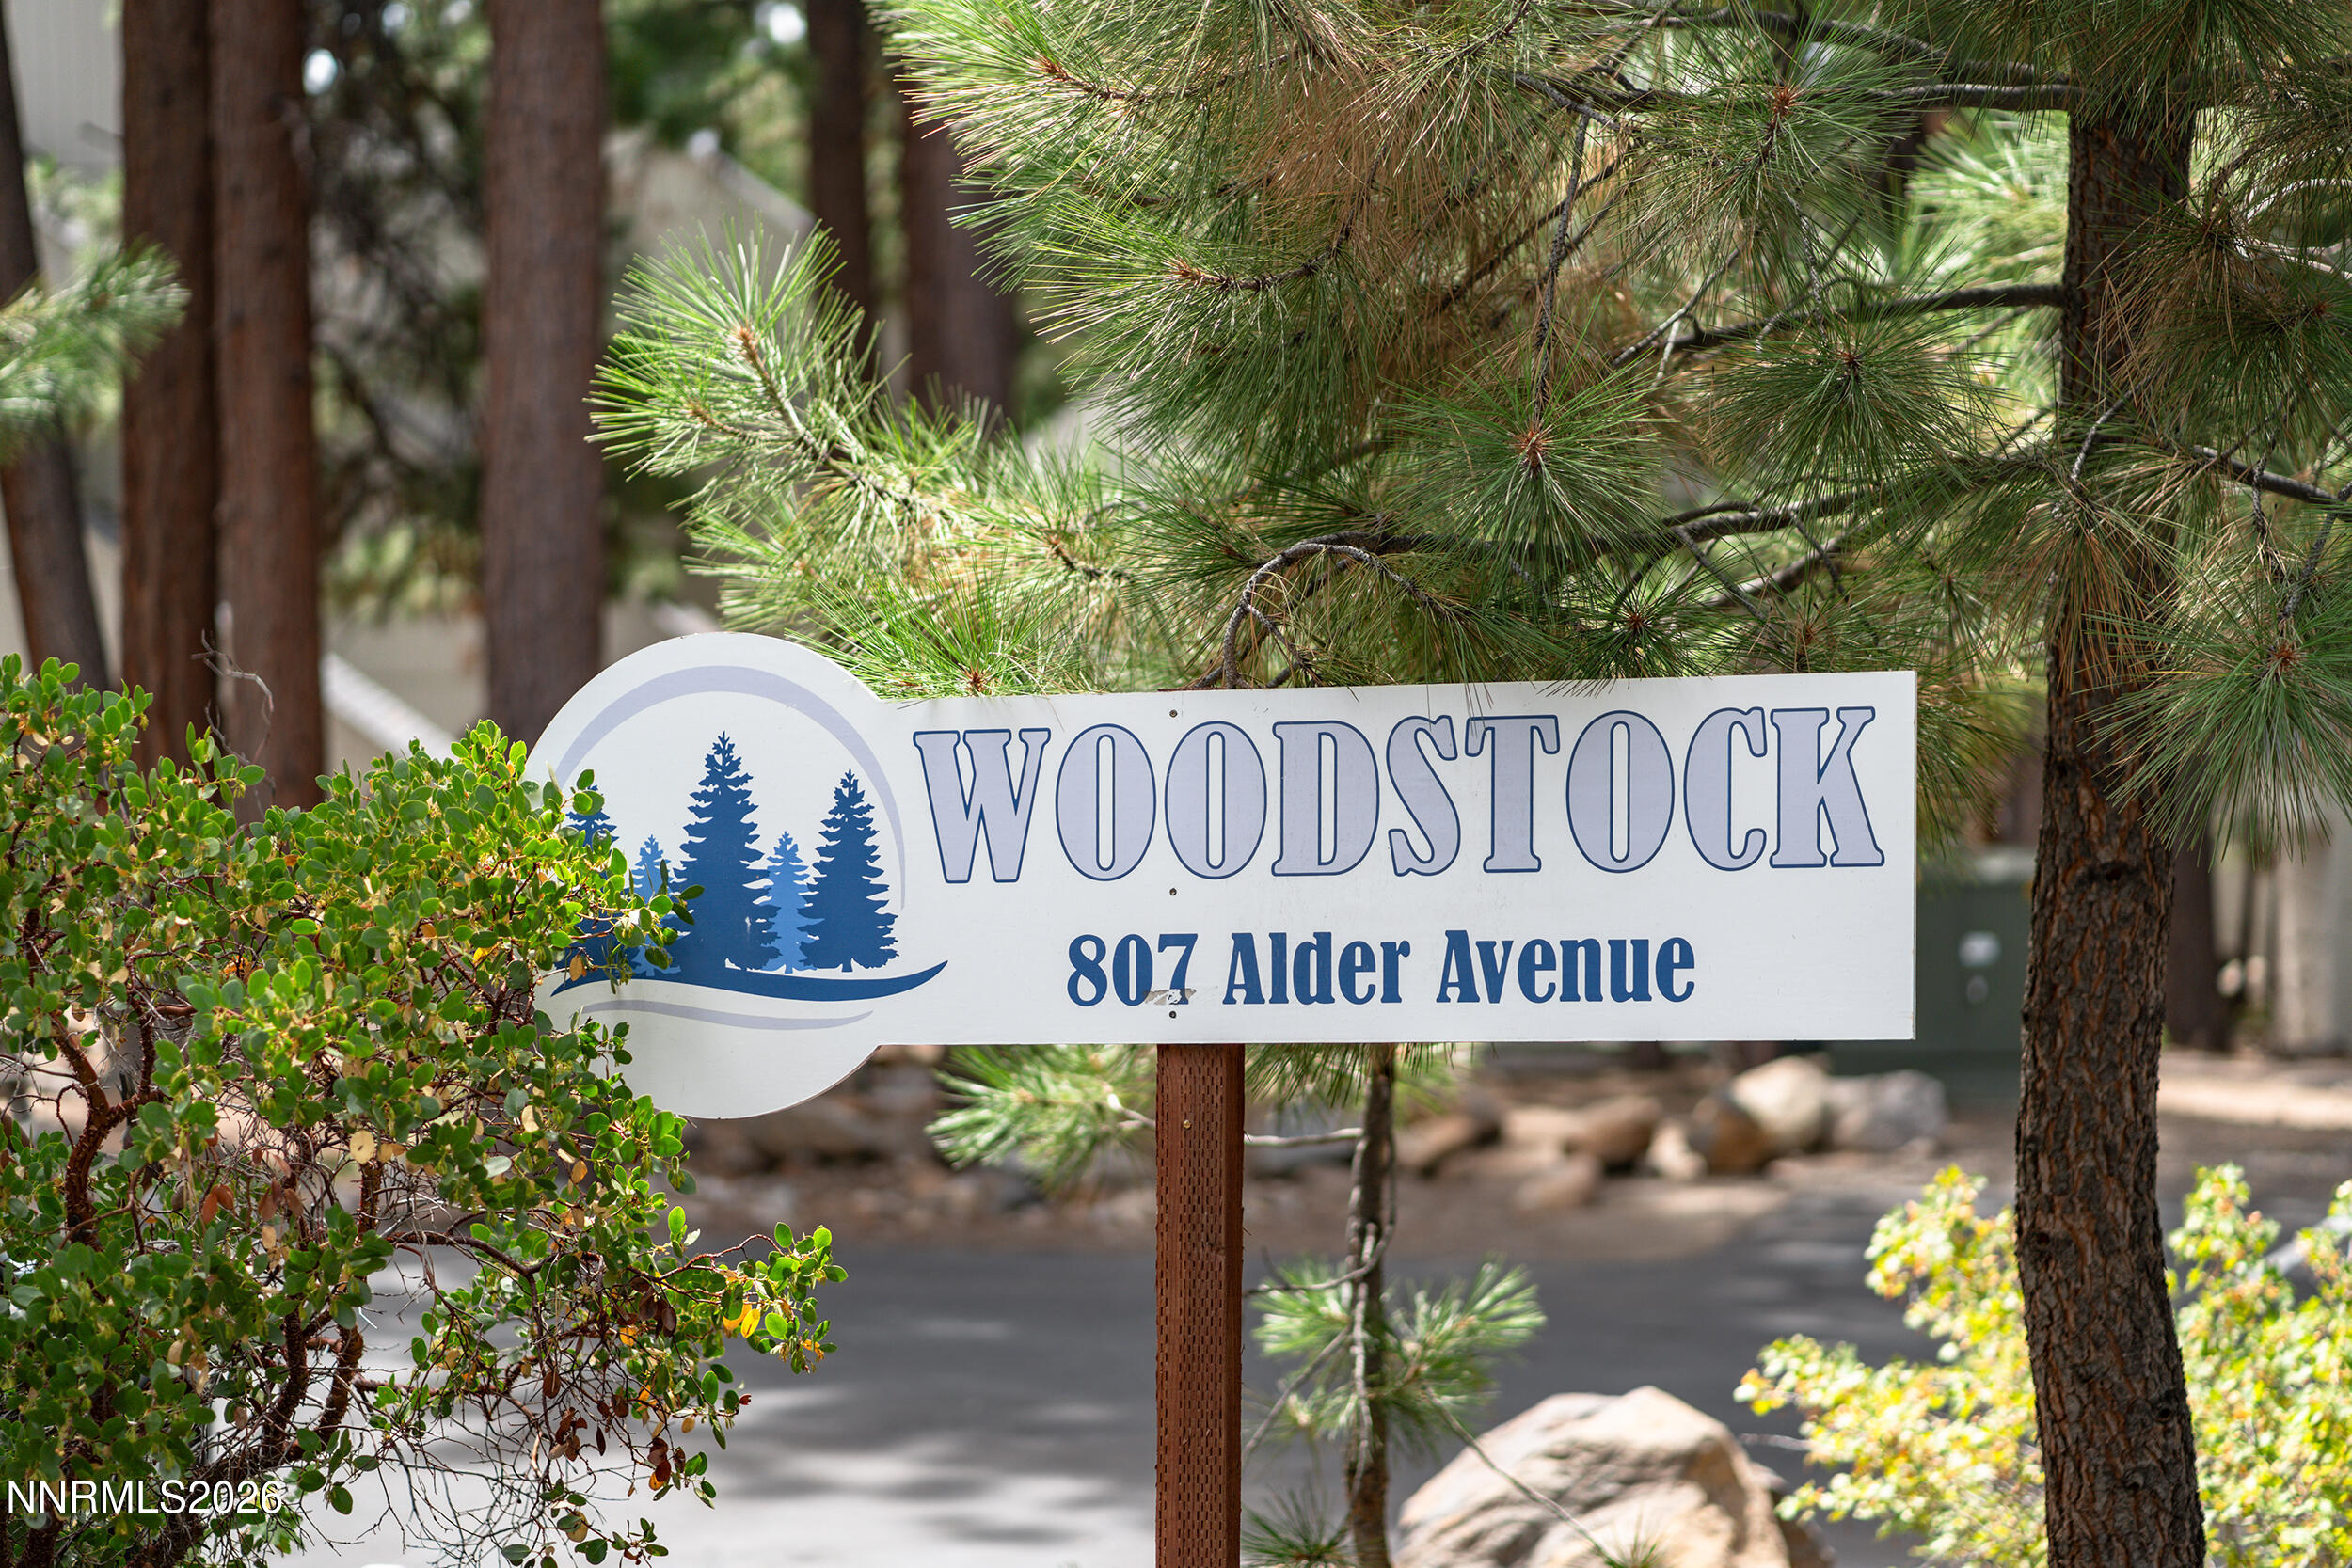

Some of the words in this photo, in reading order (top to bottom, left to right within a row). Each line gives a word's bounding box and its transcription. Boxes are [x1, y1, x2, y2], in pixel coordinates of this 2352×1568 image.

[913, 705, 1884, 884] WOODSTOCK
[1066, 933, 1199, 1006] 807
[1222, 930, 1411, 1006] Alder
[1436, 928, 1696, 1004] Avenue
